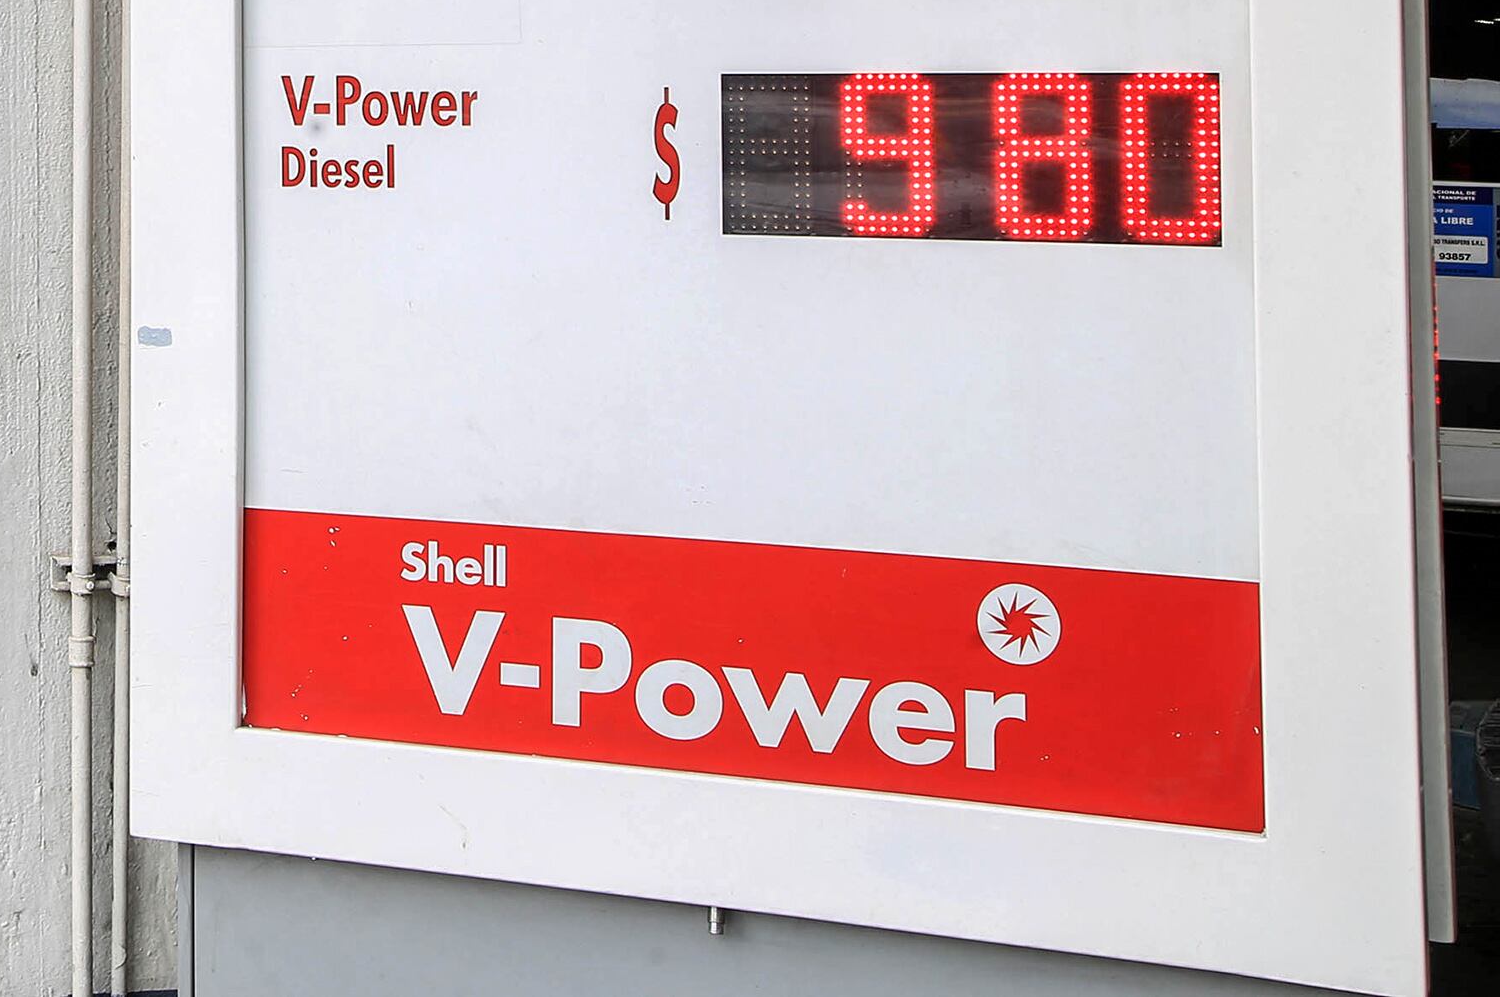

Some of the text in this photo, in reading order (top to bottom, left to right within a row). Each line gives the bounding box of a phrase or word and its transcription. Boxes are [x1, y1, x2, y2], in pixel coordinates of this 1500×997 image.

[281, 72, 1223, 243] V-Power $ 980
[281, 144, 395, 189] Diesel
[1440, 217, 1474, 225] LIBRE
[1438, 252, 1471, 261] 93857
[401, 540, 507, 588] Shell
[401, 603, 1028, 772] V-Power
